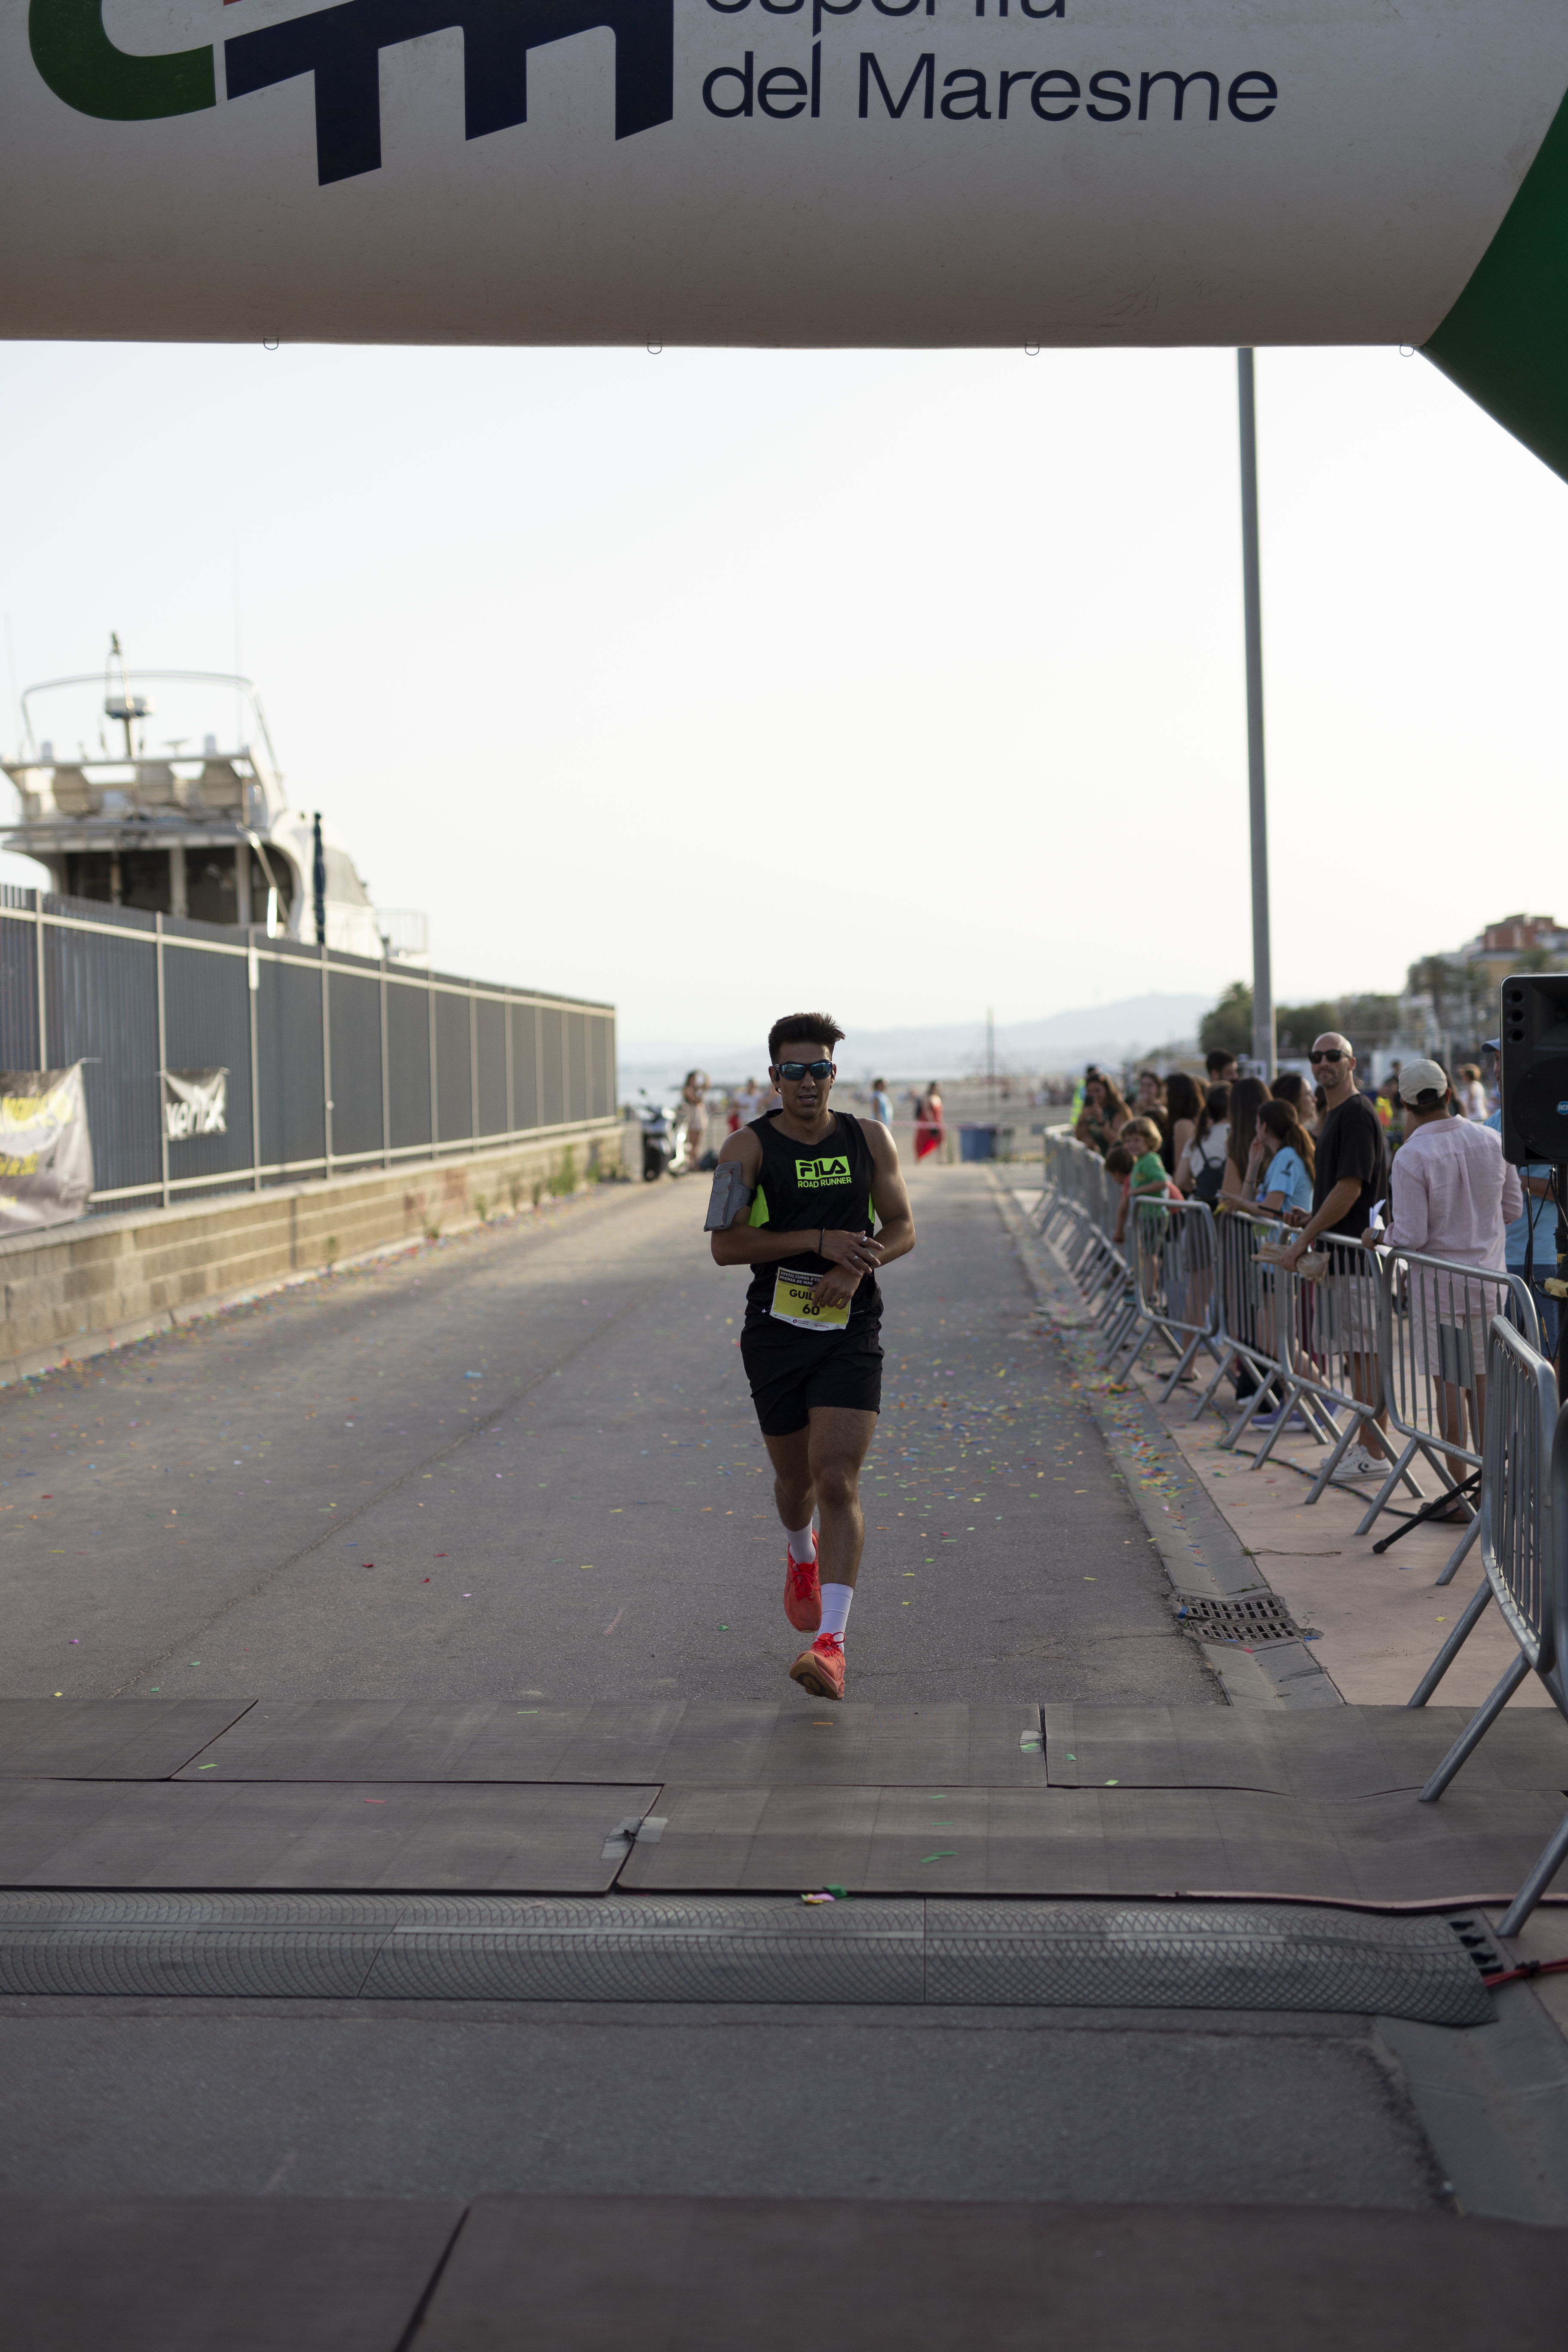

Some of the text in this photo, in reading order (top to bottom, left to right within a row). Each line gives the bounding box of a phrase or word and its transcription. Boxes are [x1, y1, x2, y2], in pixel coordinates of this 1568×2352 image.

[702, 40, 822, 119] del
[858, 52, 1278, 122] Maresme
[799, 1159, 847, 1178] FILA
[820, 1177, 852, 1186] RUNNER
[789, 1289, 813, 1301] GUIL
[802, 1304, 820, 1316] 60
